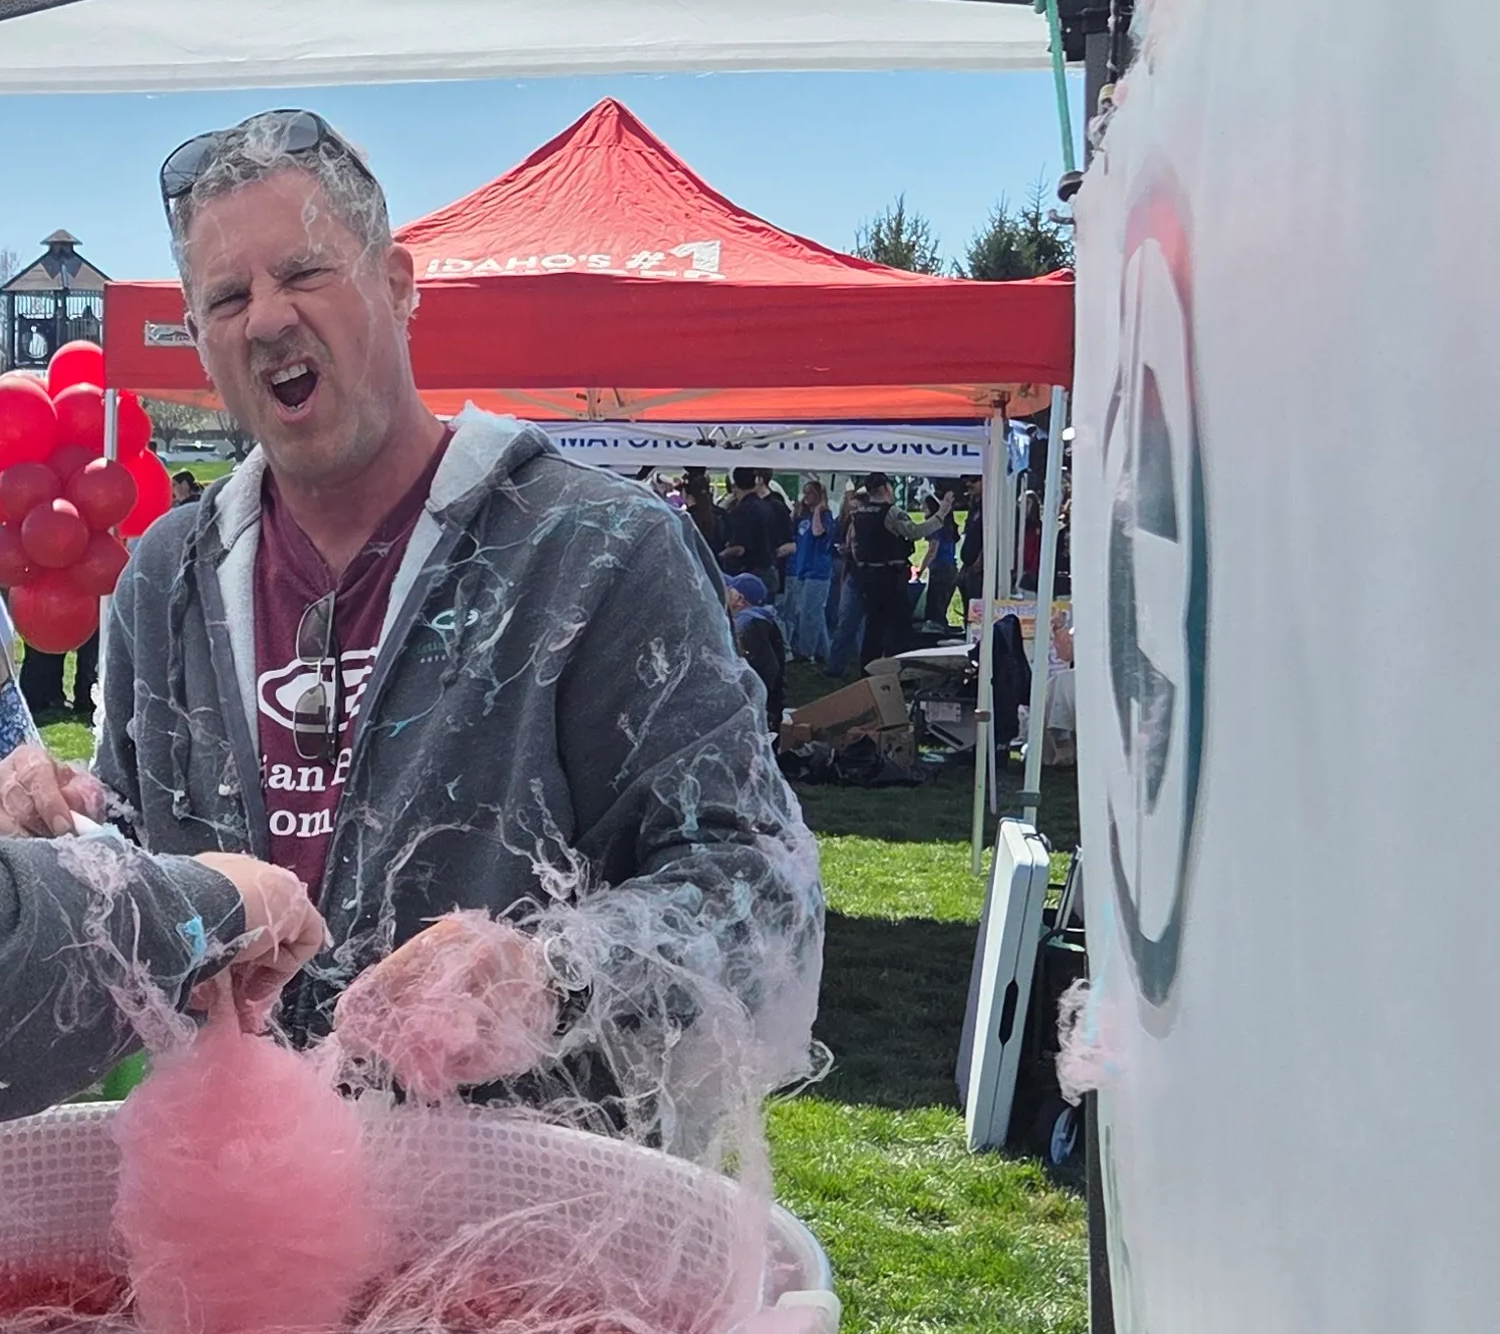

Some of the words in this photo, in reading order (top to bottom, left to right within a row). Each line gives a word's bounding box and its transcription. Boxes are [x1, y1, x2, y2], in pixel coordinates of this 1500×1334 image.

[426, 253, 612, 273] IDAHO'S
[625, 239, 722, 274] #1
[269, 808, 338, 838] om
